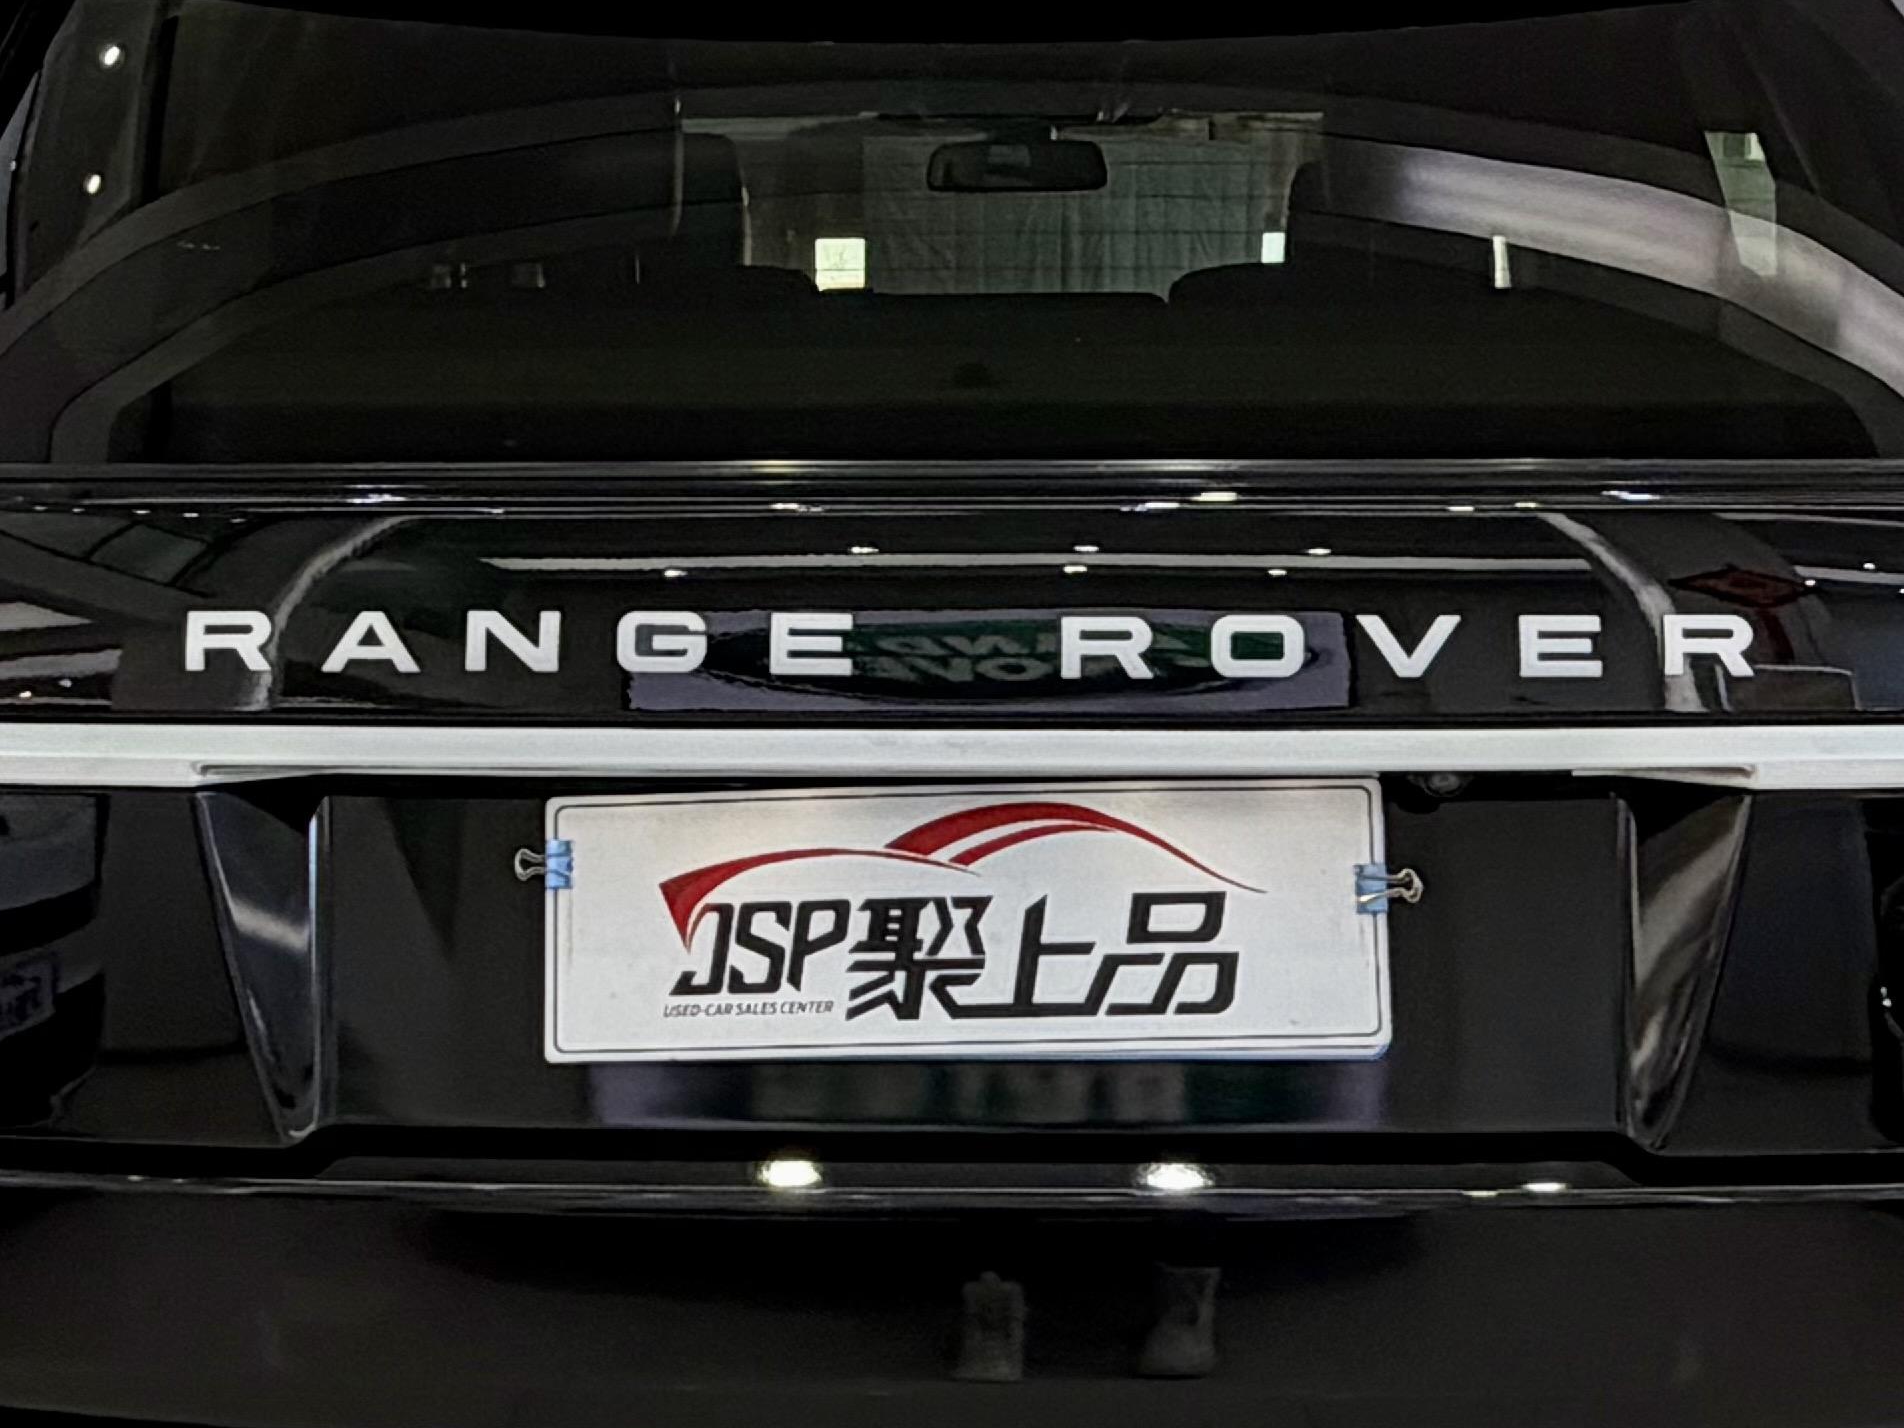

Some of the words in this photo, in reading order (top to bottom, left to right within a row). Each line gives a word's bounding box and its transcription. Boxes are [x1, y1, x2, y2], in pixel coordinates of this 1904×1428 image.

[185, 610, 854, 676] RANGE
[1060, 614, 1756, 678] ROVER
[669, 899, 851, 996] JSP
[735, 1001, 777, 1015] SALES
[780, 1000, 835, 1014] CENTER
